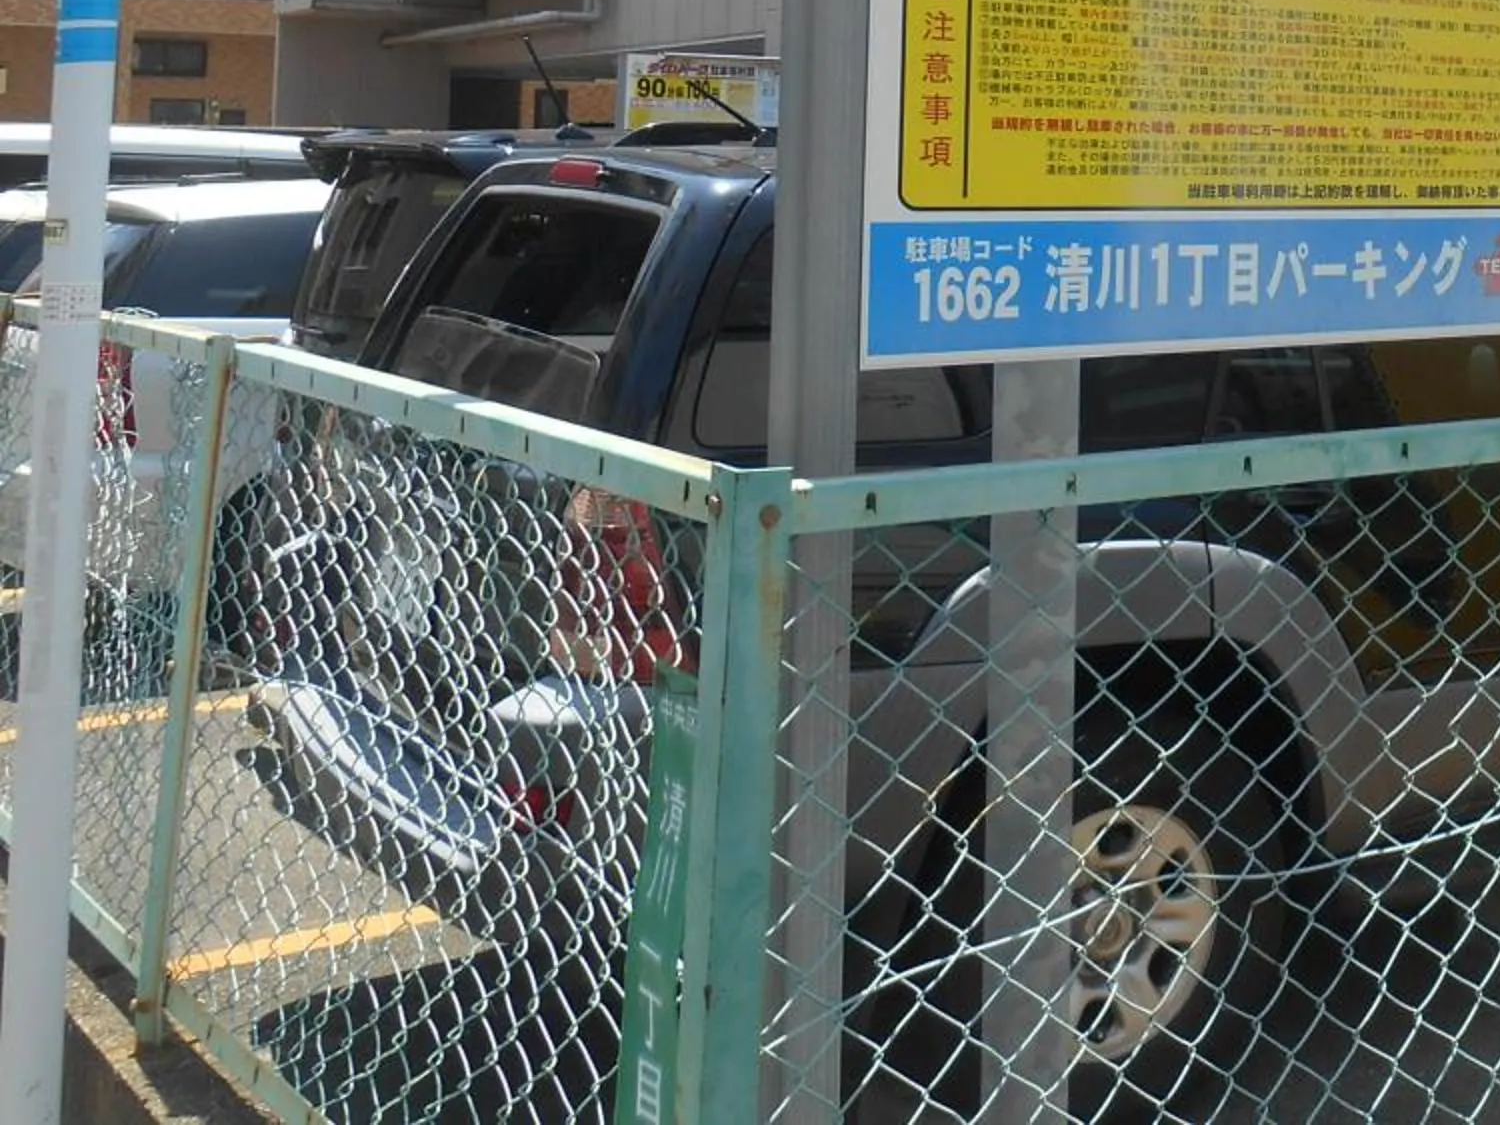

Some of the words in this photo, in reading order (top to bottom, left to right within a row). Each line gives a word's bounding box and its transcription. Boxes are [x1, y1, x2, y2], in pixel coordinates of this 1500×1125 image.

[905, 235, 1033, 263] 駐車場コード
[912, 265, 1021, 323] 1662
[1043, 234, 1467, 314] 清川1丁目パーキング
